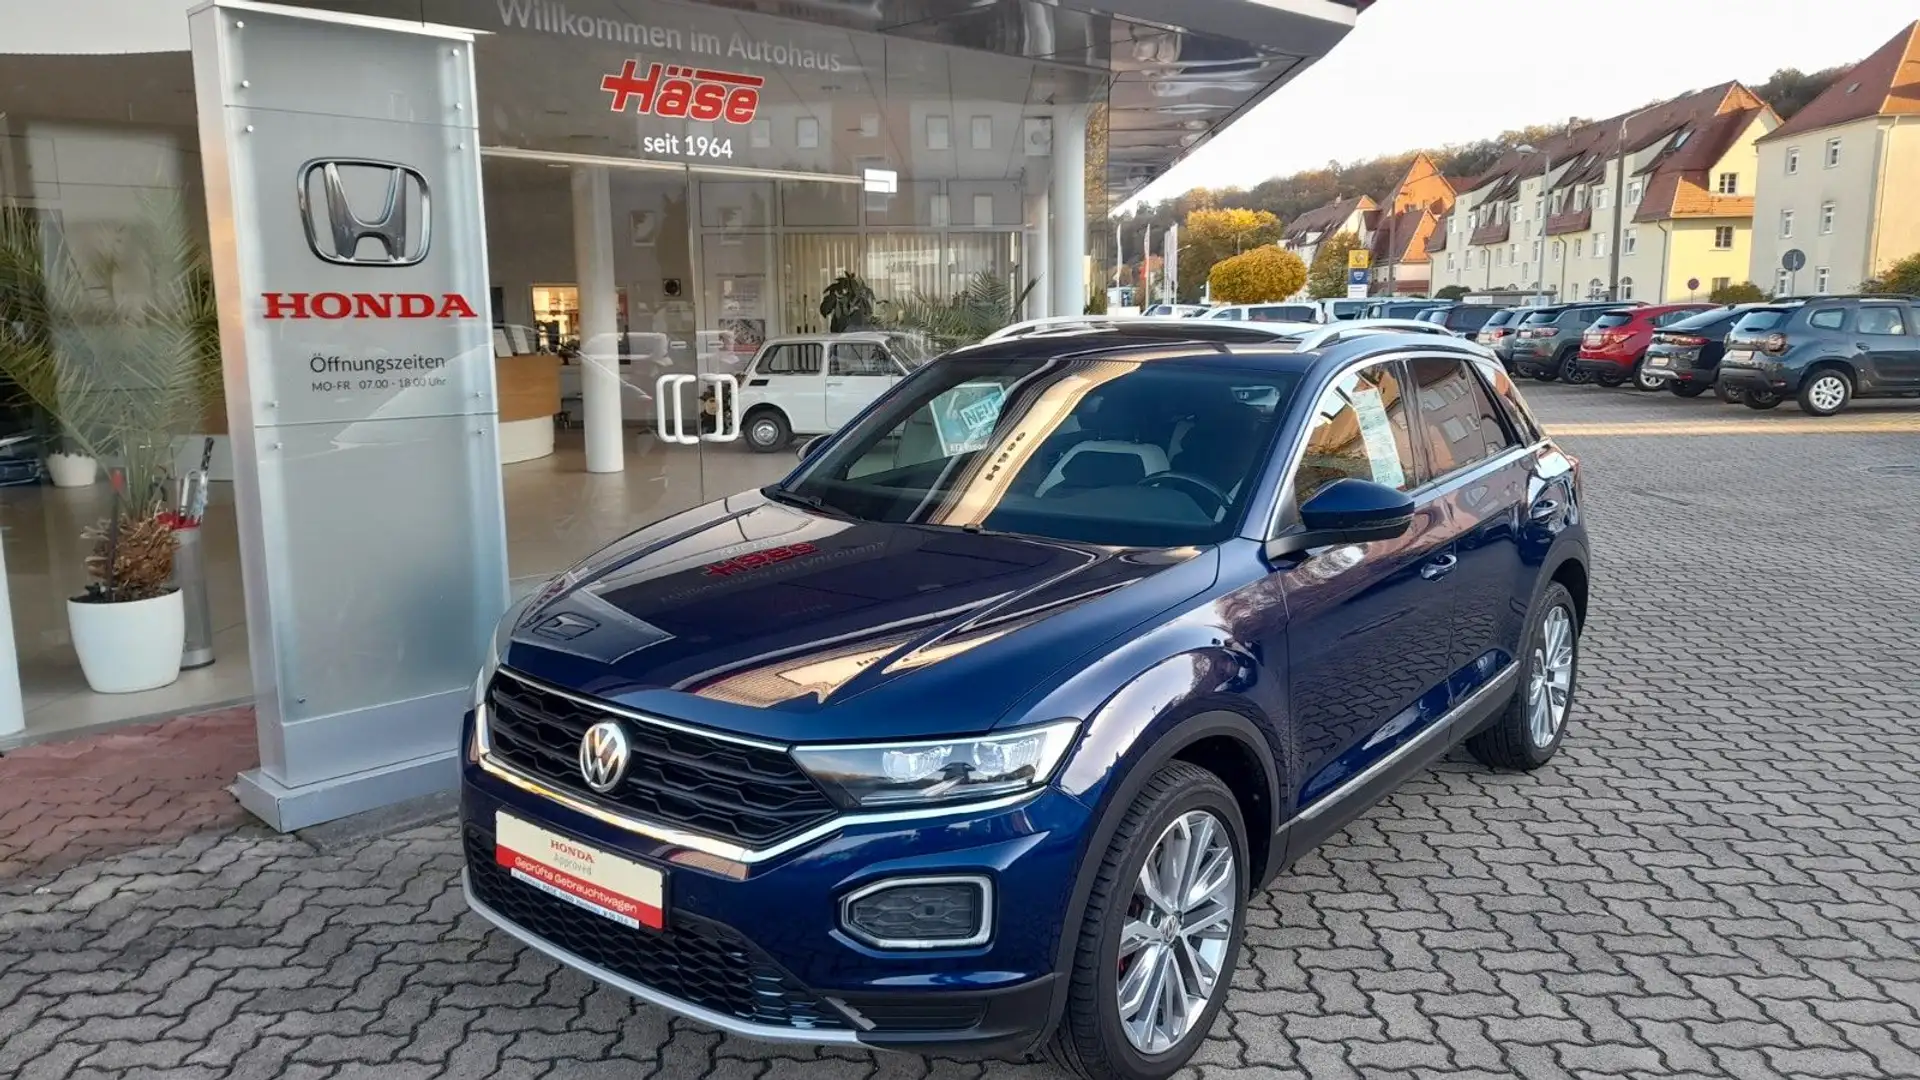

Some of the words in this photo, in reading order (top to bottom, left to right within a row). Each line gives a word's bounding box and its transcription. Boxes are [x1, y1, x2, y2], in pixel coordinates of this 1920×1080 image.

[498, 0, 683, 50] Willkommen
[690, 24, 720, 54] im
[728, 32, 841, 71] Autohaus
[600, 59, 765, 124] Häse
[643, 133, 679, 154] seit
[685, 135, 733, 158] 1964
[261, 292, 478, 319] HONDA
[310, 353, 445, 374] Öffnungszeiten
[550, 839, 595, 864] HONDA
[553, 853, 592, 876] Approved
[514, 856, 554, 881] Geprüfte
[554, 873, 638, 913] Gebrauchtwagen
